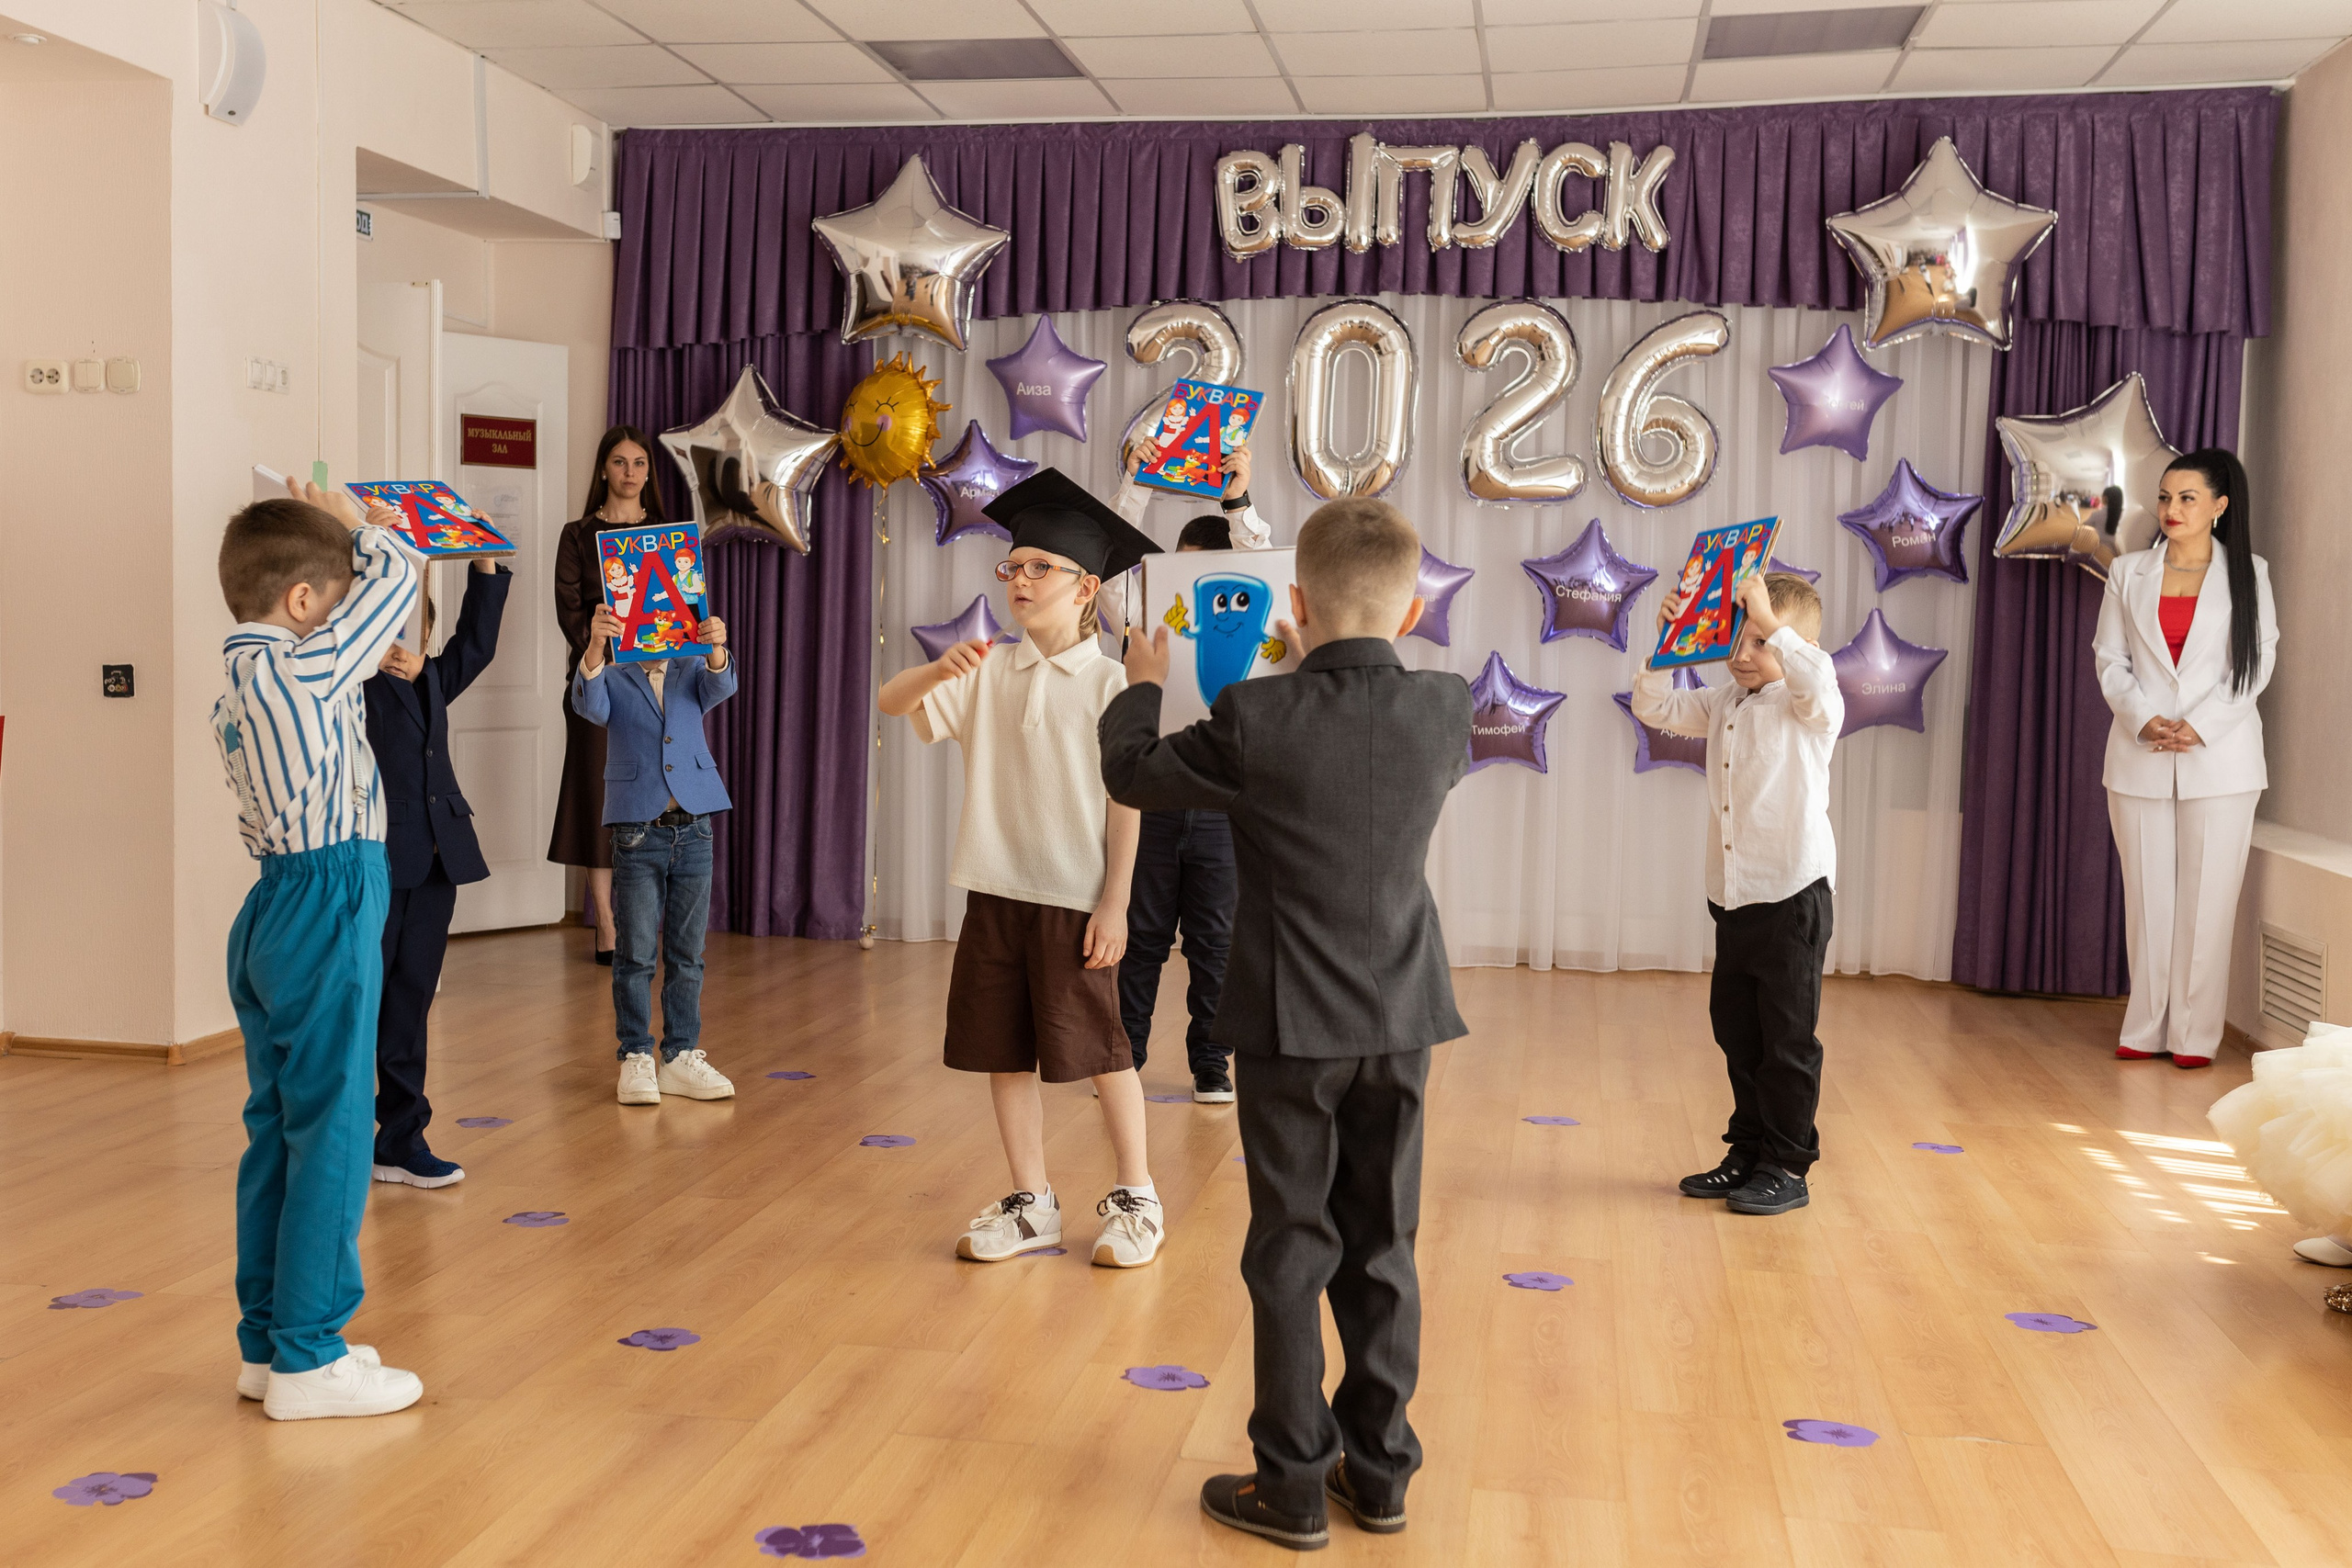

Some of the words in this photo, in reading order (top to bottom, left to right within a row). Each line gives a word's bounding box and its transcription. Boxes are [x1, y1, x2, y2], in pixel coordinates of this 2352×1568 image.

[1215, 132, 1675, 261] ВЫПУСК
[1016, 381, 1052, 396] Аиза
[1173, 382, 1259, 411] БУКВАРЬ
[1117, 297, 1732, 512] 2026
[468, 427, 532, 442] МУЗЫКАЛЬНЫЙ
[492, 444, 508, 454] ЗАЛ
[351, 483, 451, 496] БУКВАРЬ
[601, 529, 698, 557] БУКВАРЬ
[1691, 523, 1772, 556] БУКВАРЬ
[1892, 532, 1936, 548] Роман
[1555, 584, 1623, 603] Стефания
[1861, 682, 1906, 695] Элина
[1472, 722, 1525, 737] Тимофей
